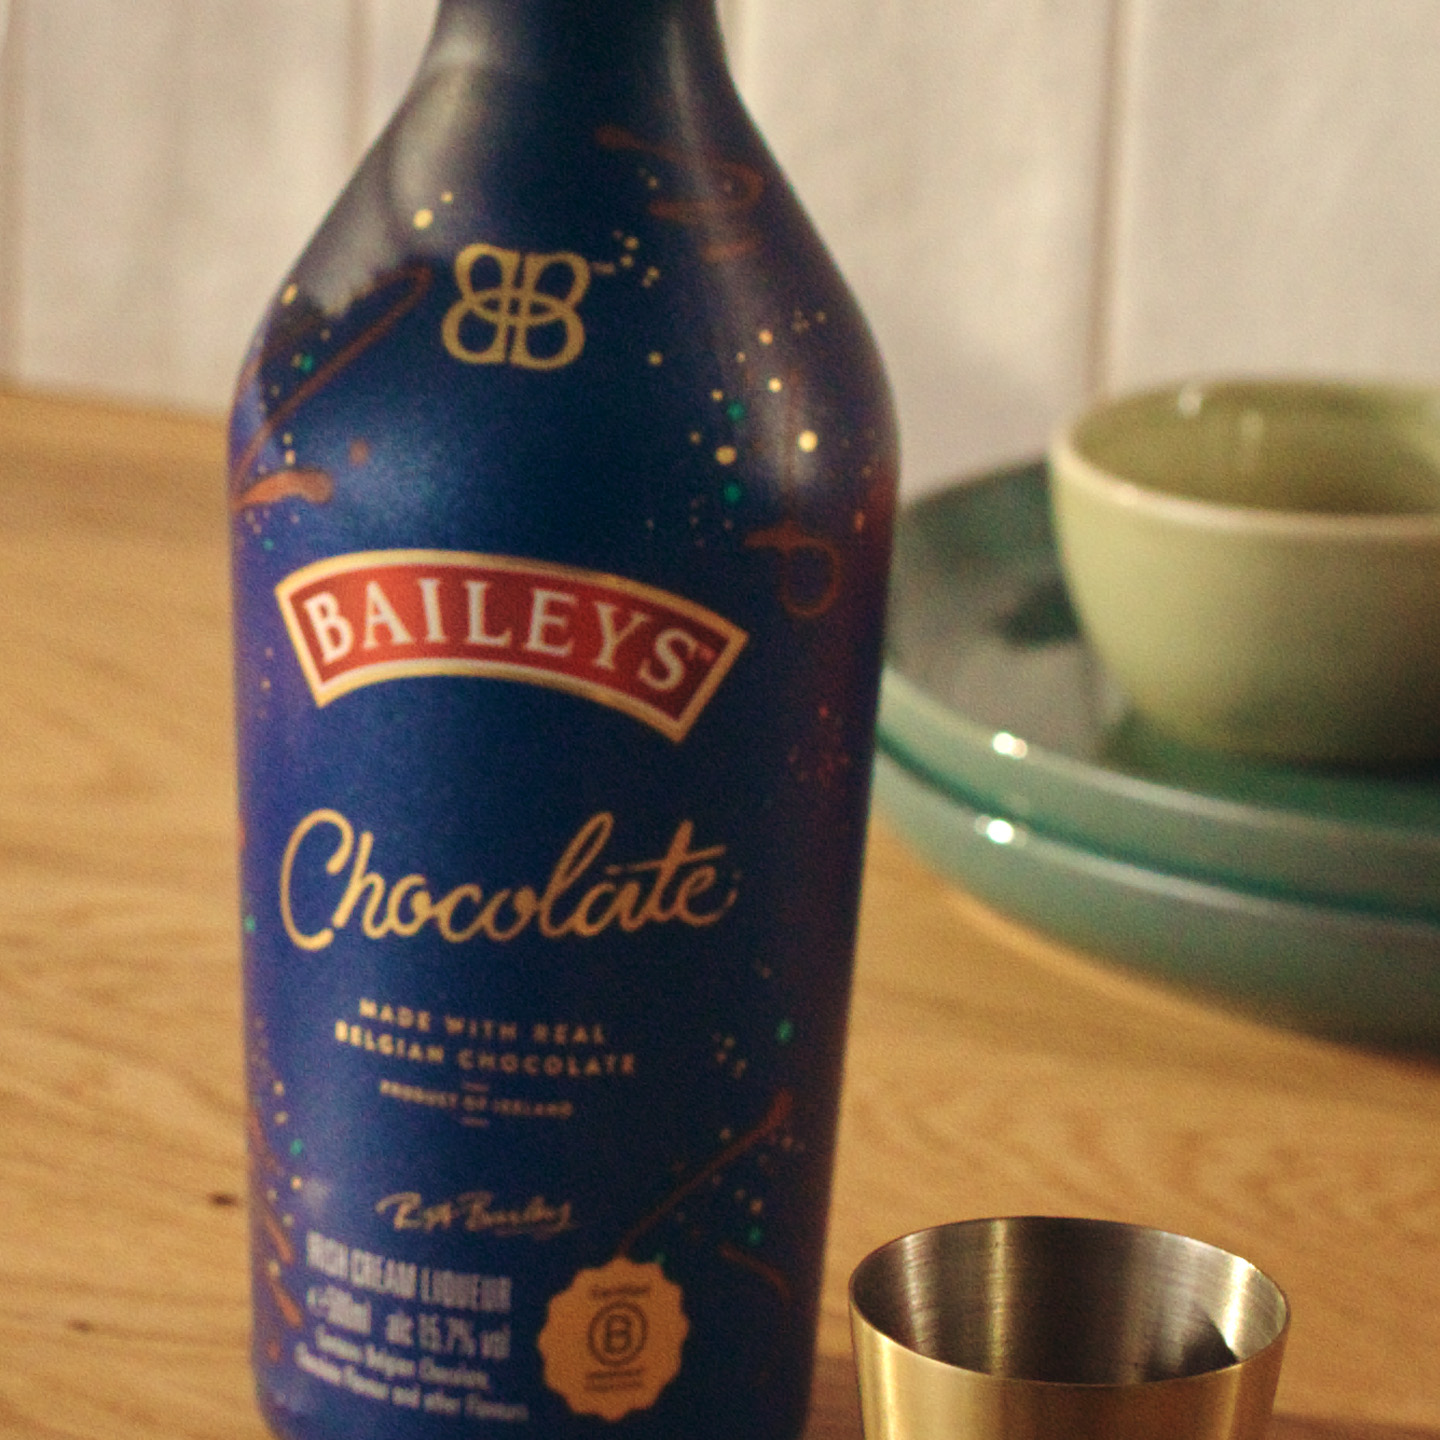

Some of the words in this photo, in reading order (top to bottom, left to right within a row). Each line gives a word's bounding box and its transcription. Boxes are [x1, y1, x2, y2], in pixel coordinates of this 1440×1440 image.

[304, 577, 699, 693] BAILEYS
[279, 807, 741, 952] Chocolate
[334, 1018, 445, 1064] BELGIAN
[457, 1048, 636, 1078] CHOCOLATE
[359, 998, 432, 1034] MADE
[445, 1014, 518, 1043] WITH
[532, 1022, 605, 1046] REAL
